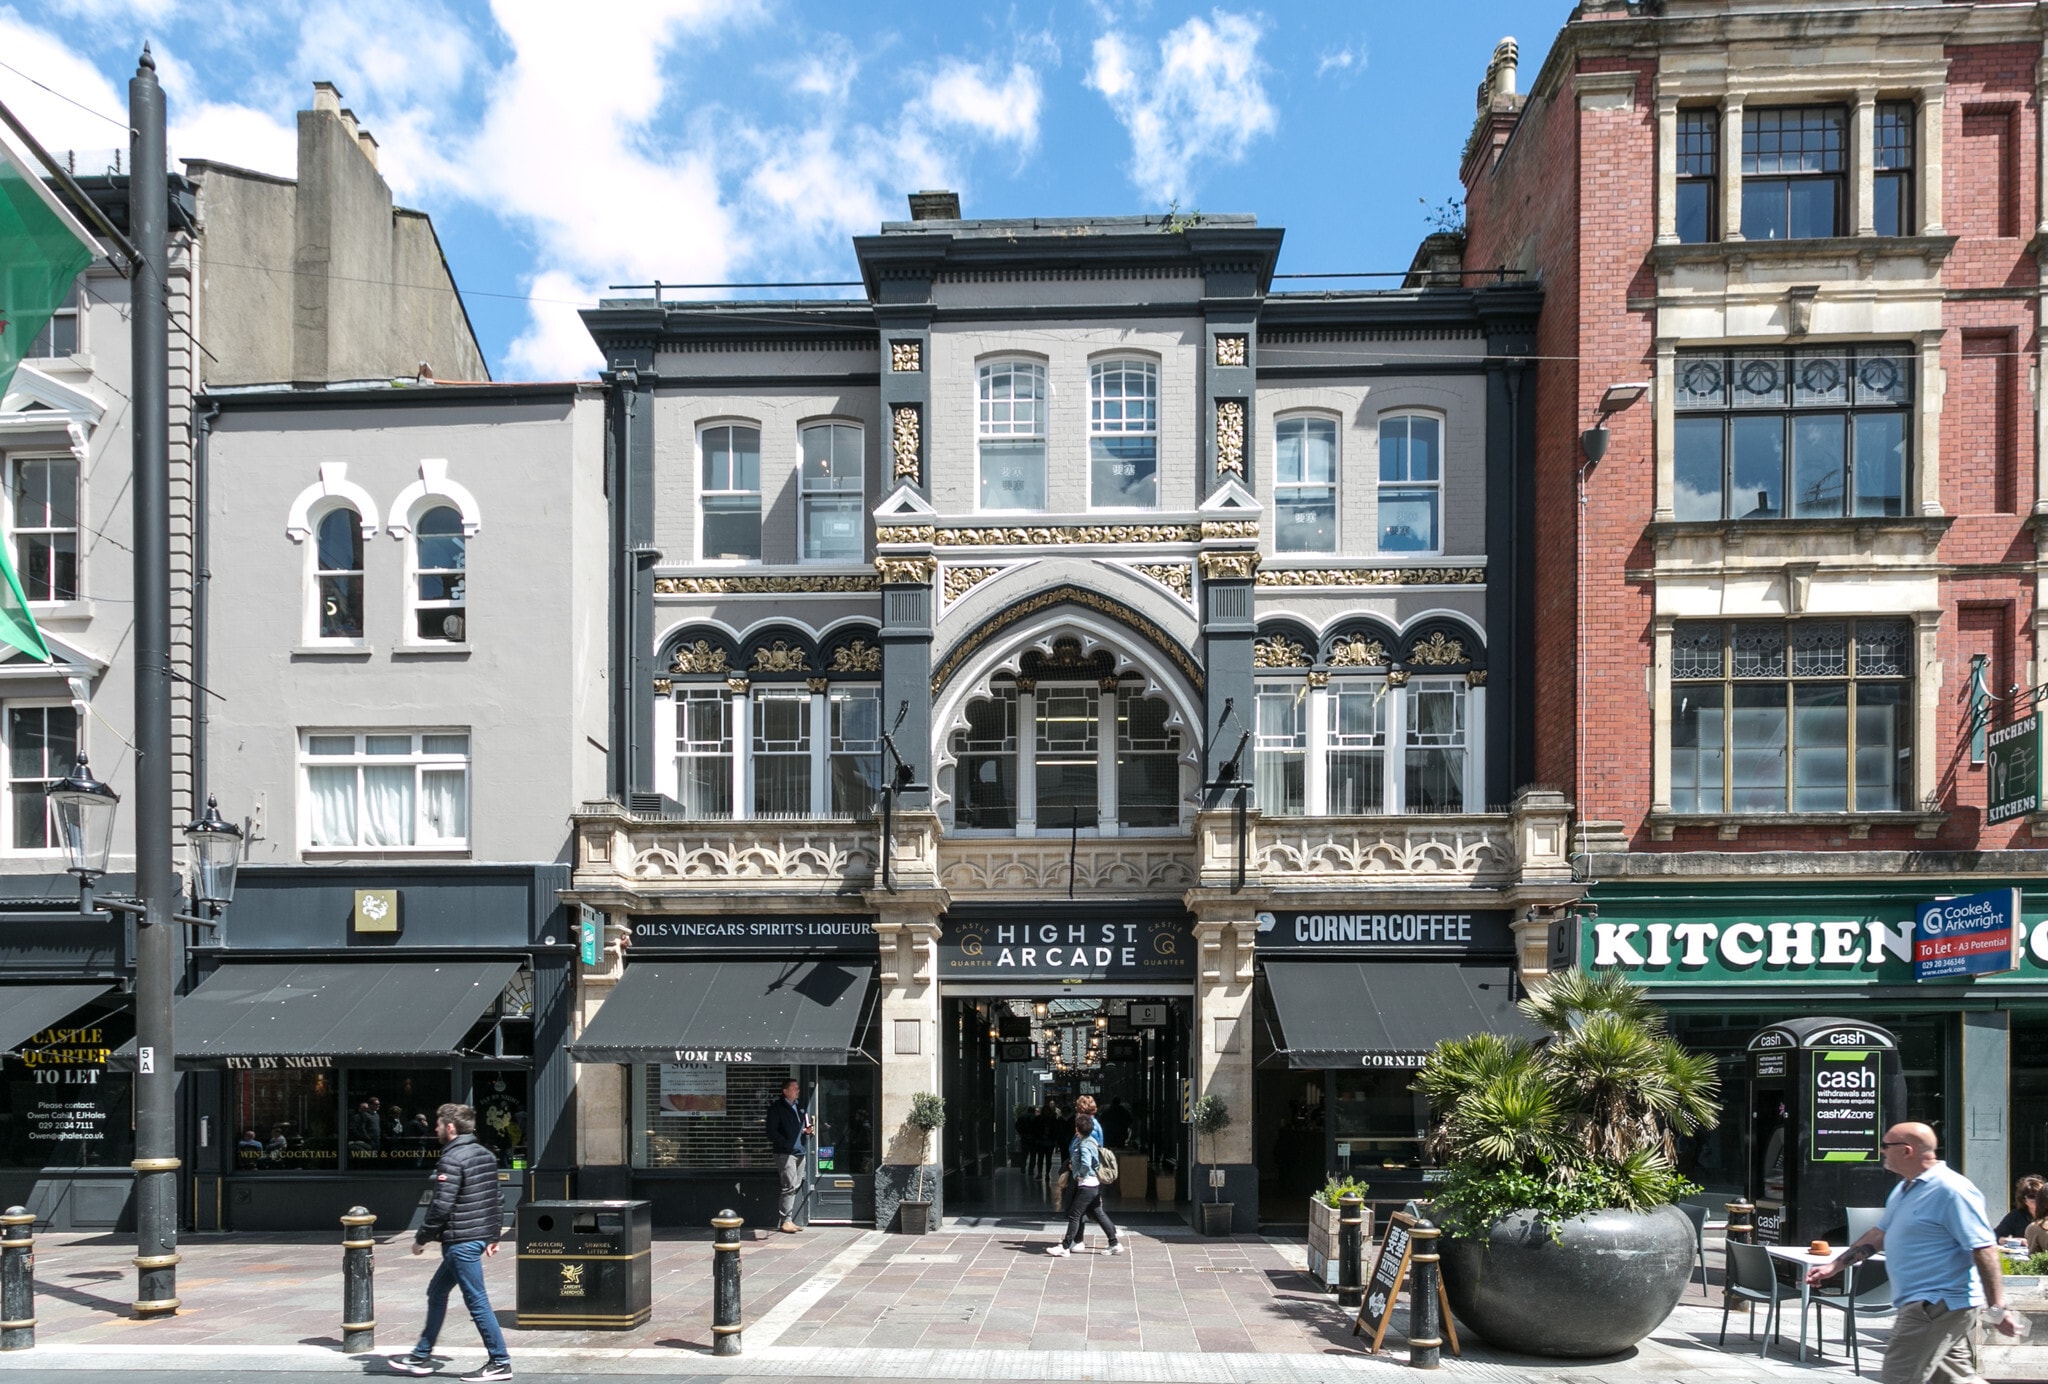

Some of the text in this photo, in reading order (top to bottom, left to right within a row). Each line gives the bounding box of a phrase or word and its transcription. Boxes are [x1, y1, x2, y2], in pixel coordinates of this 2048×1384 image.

[1988, 716, 2036, 748] KITCHENS
[1988, 795, 2036, 822] KITCHENS
[955, 922, 991, 936] CASTLE
[1147, 920, 1184, 934] CASTLE
[1945, 912, 2004, 932] Arkwright
[997, 924, 1138, 944] HIGH ST.
[1557, 926, 1565, 953] C
[1920, 944, 1932, 956] To
[1934, 942, 1952, 955] Let
[1958, 943, 1970, 951] A3
[1970, 936, 2007, 950] Potential
[950, 960, 992, 968] QUARTER
[996, 947, 1137, 967] ARCADE
[1143, 959, 1185, 967] QUARTER
[1922, 957, 1966, 969] 029 20 346346
[1921, 966, 1967, 976] www.coark.com
[32, 1028, 103, 1044] CASTLE
[1760, 1033, 1781, 1047] cash
[1830, 1031, 1866, 1045] cash
[23, 1049, 111, 1068] QUARTER
[142, 1049, 150, 1059] 5
[675, 1050, 753, 1062] VOM FASS
[1361, 1055, 1427, 1066] CORNER
[142, 1062, 151, 1072] A
[226, 1056, 333, 1069] FLY BY NIGHT
[33, 1069, 100, 1084] TO LET
[1817, 1066, 1876, 1088] cash
[1817, 1090, 1876, 1098] withdrawals and
[38, 1102, 95, 1110] Please contact:
[76, 1121, 94, 1129] 7111
[240, 1150, 266, 1158] WINE
[279, 1150, 338, 1159] COCKTAILS
[351, 1150, 442, 1158] WINE & COCKTAIL
[1757, 1214, 1780, 1229] cash
